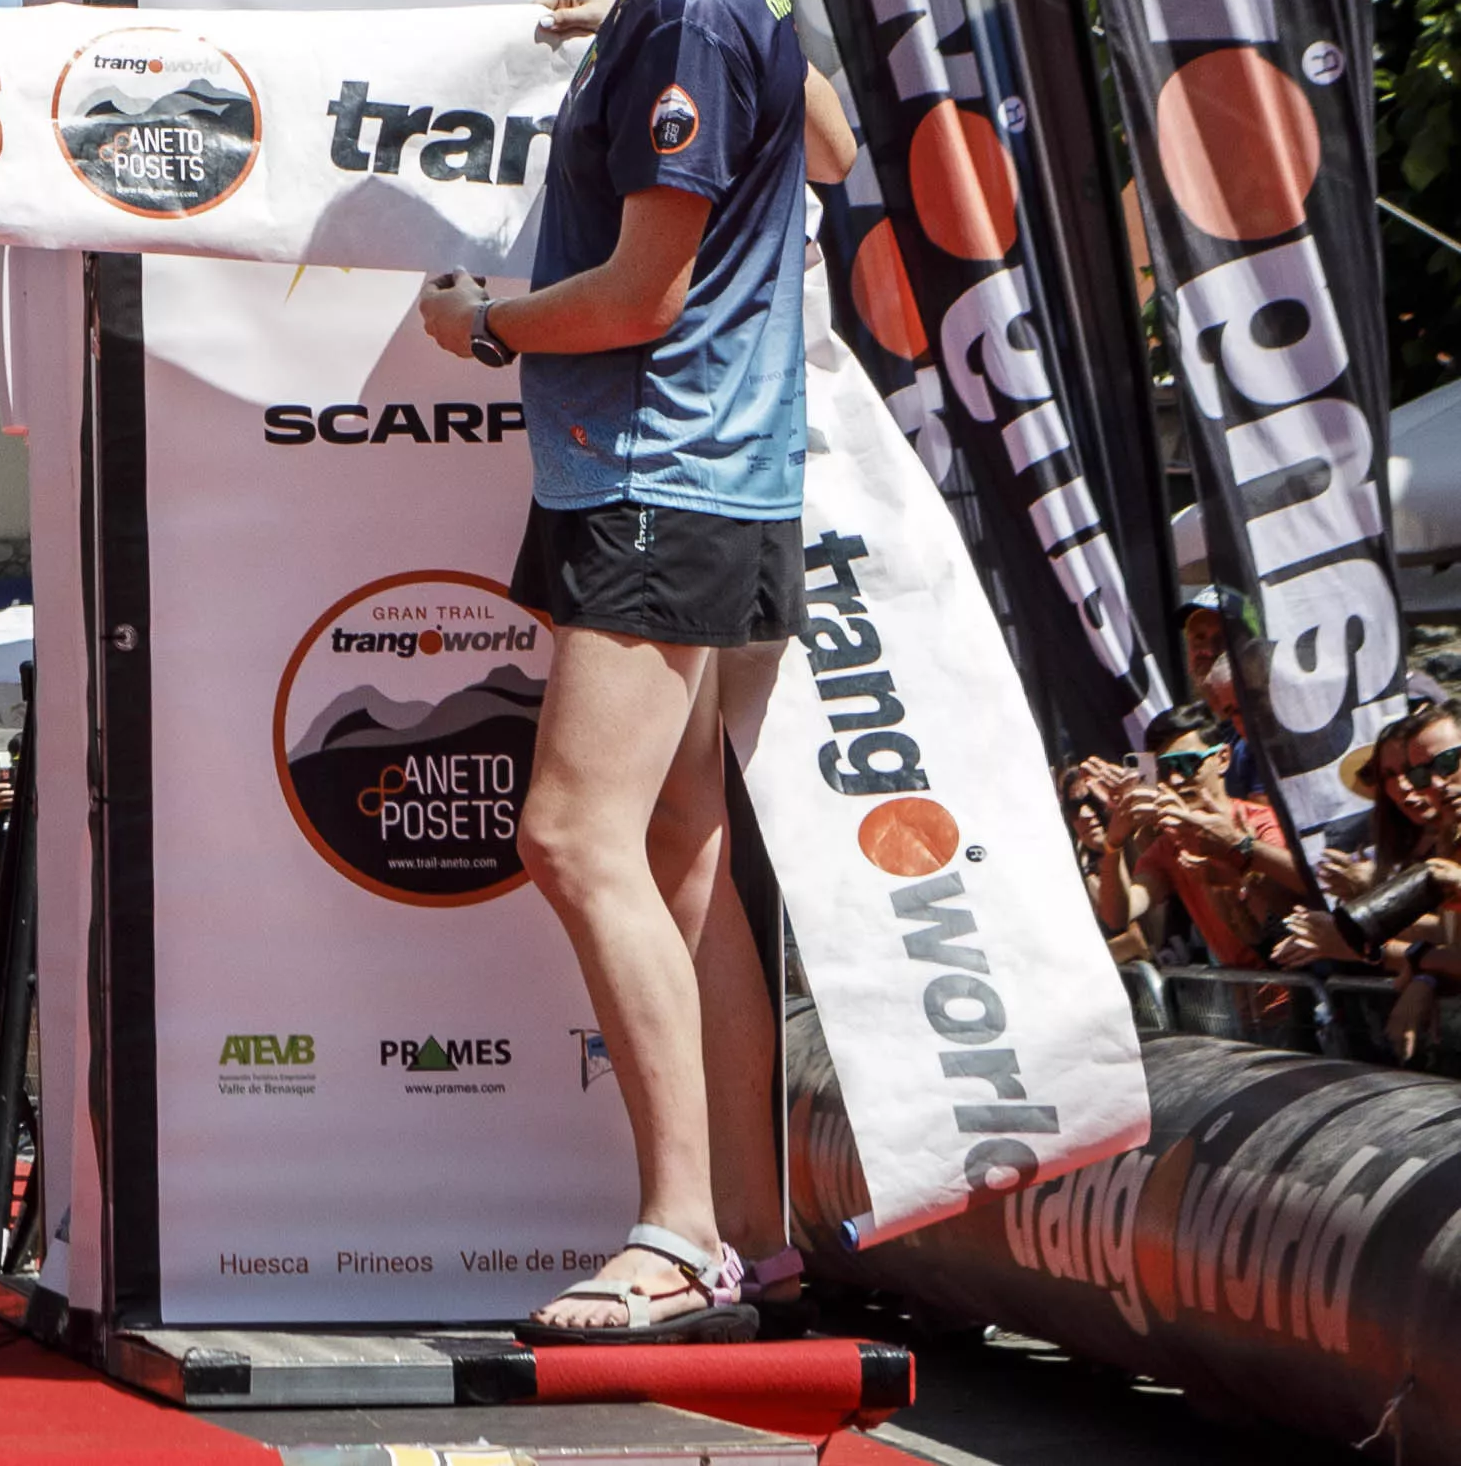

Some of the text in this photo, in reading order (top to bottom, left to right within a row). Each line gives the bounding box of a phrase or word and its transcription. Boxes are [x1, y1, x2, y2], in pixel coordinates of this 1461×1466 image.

[130, 127, 204, 154] ANETO
[115, 154, 205, 183] POSETS
[373, 606, 493, 620] GRAN TRAIL
[405, 755, 514, 795] ANETO
[382, 799, 515, 840] POSETS
[388, 856, 498, 870] www.trail-aneto.com
[219, 1034, 315, 1065] ATEVB
[220, 1253, 309, 1274] Huesca
[337, 1252, 433, 1273] Pirineos
[460, 1251, 518, 1271] Valle
[526, 1250, 554, 1270] de
